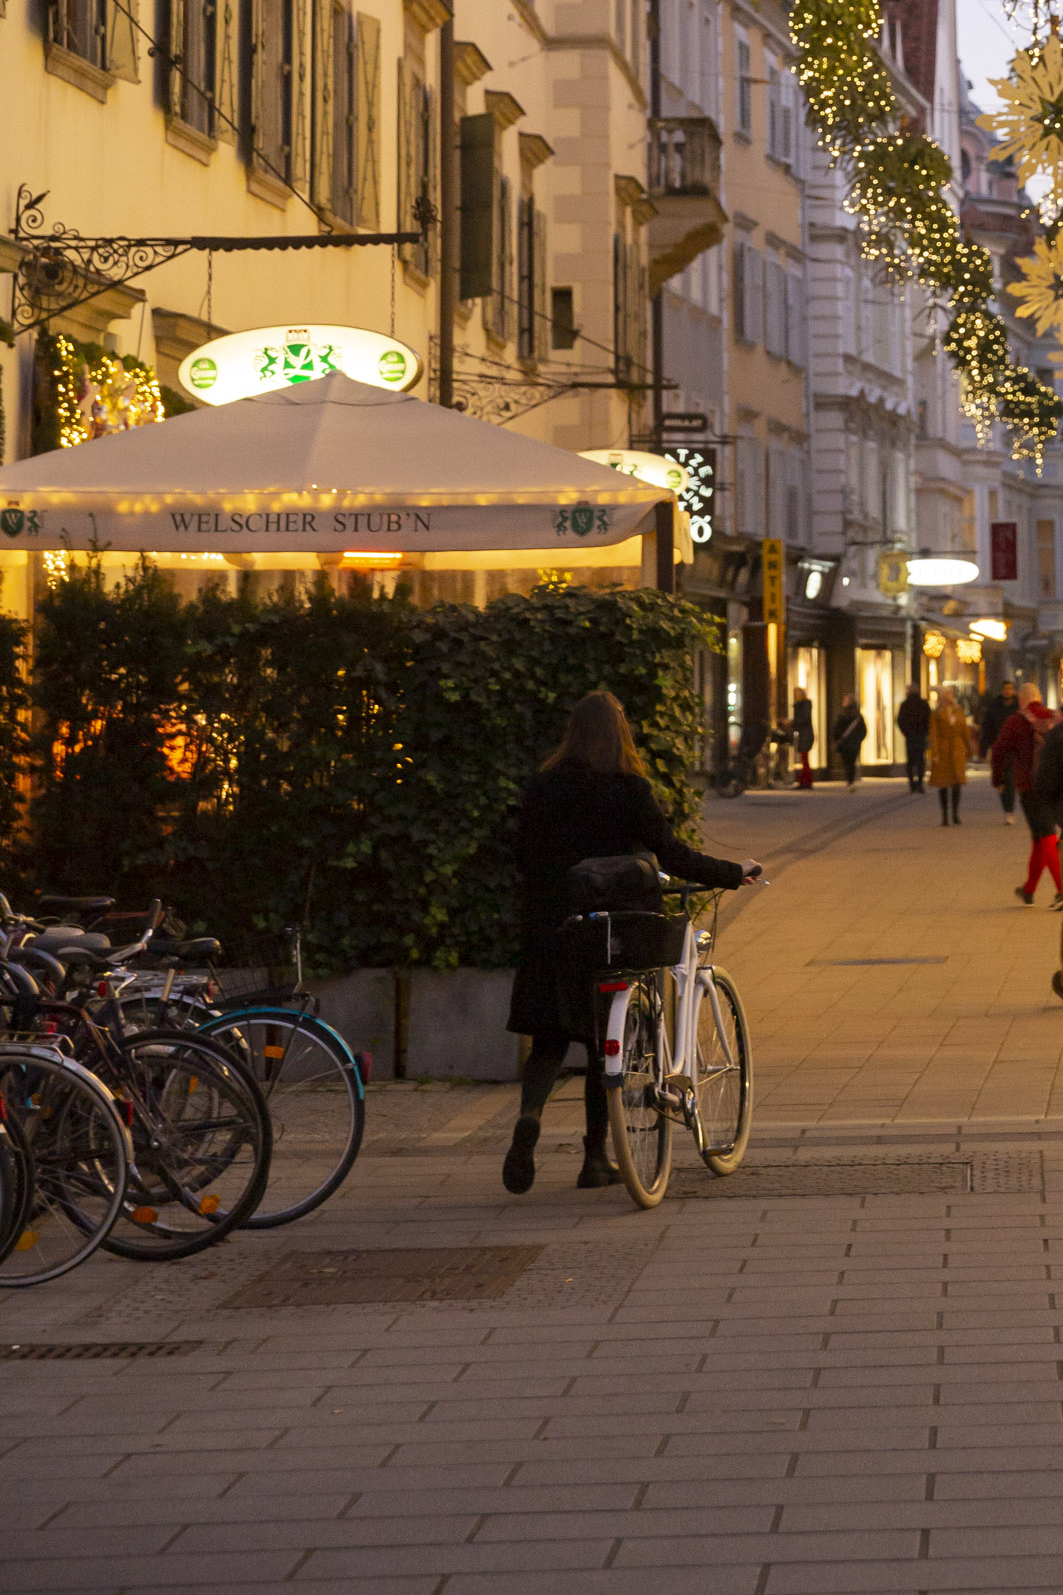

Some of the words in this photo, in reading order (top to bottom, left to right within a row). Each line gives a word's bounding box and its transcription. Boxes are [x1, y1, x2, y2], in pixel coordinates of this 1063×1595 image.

[170, 512, 318, 533] WELSCHER
[333, 512, 432, 533] STUB'N
[767, 543, 779, 620] ANTIK
